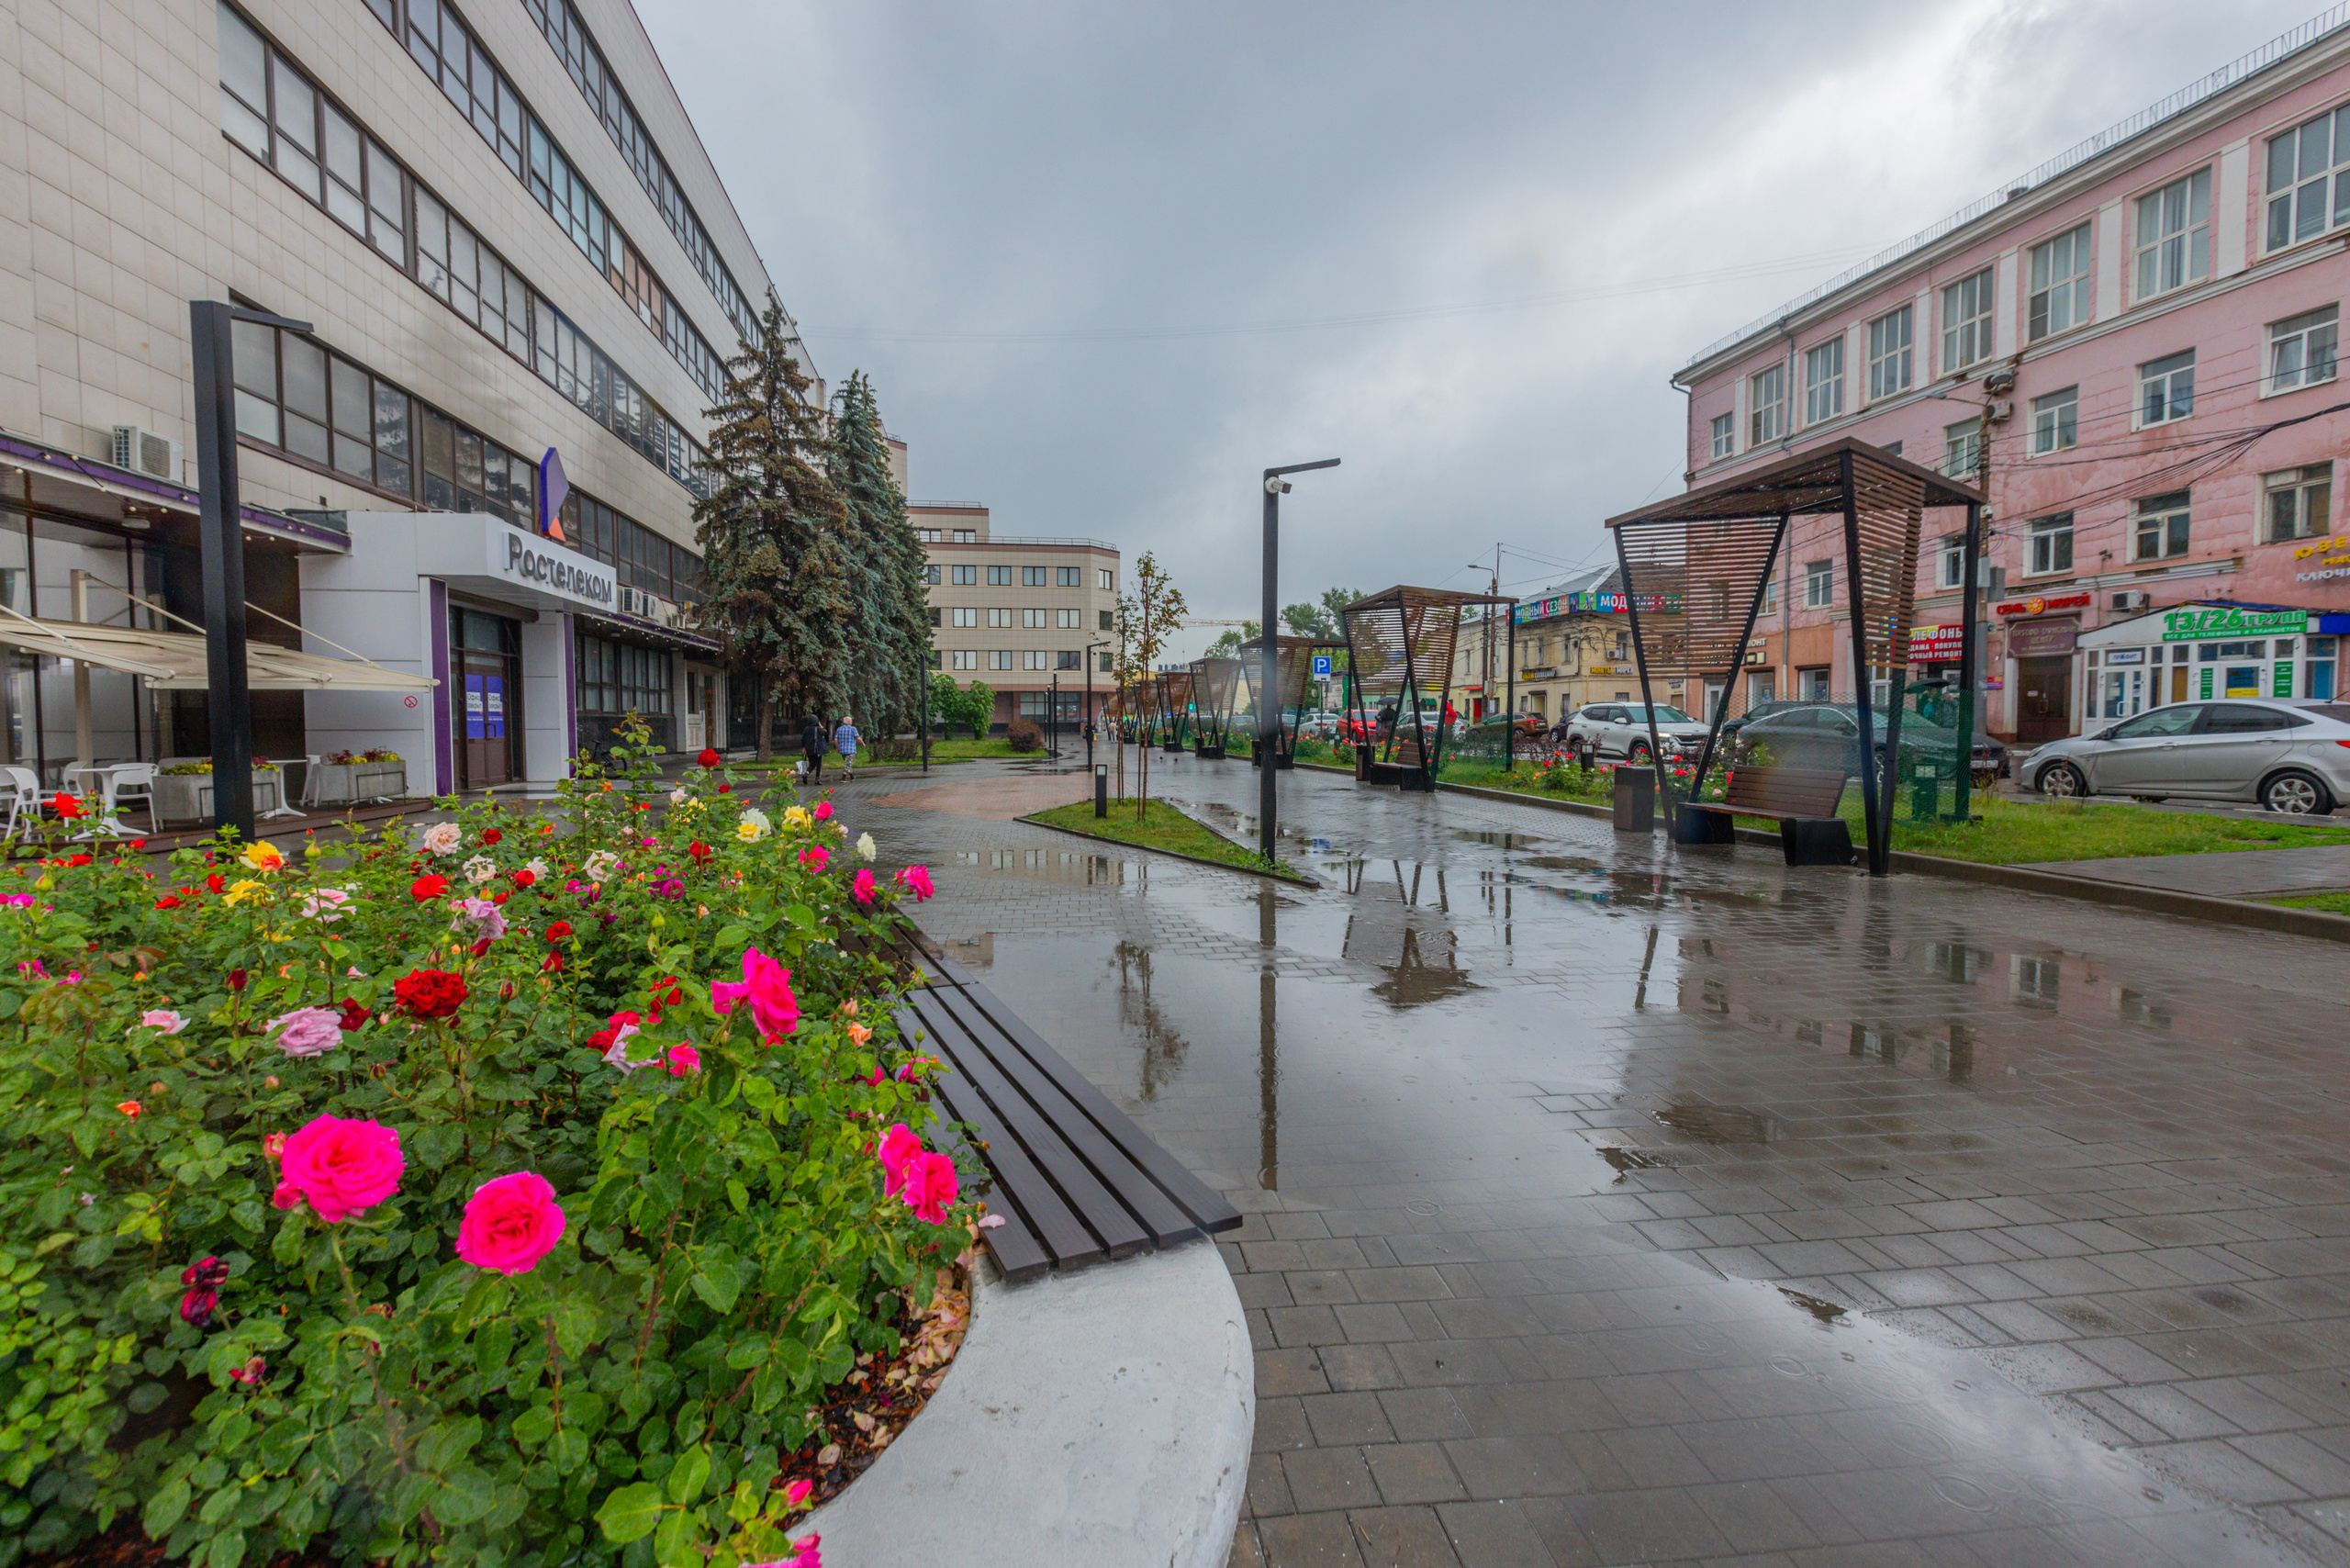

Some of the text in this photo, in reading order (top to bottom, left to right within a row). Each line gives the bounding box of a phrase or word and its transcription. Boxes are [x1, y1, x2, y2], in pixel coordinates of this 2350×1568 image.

[508, 532, 612, 602] Ростелеком
[1516, 602, 1545, 618] МОДНЫЙ
[1546, 598, 1568, 612] СЕЗОН
[1996, 592, 2090, 615] СЕМЬ МОРЕЙ
[2164, 607, 2307, 632] 13/26 ГРУПП
[2199, 630, 2242, 638] ТЕЛЕФОНОВ
[2252, 626, 2300, 634] ПЛАНШЕТОВ
[1934, 650, 1963, 658] РЕМОНТ
[1317, 658, 1327, 673] P
